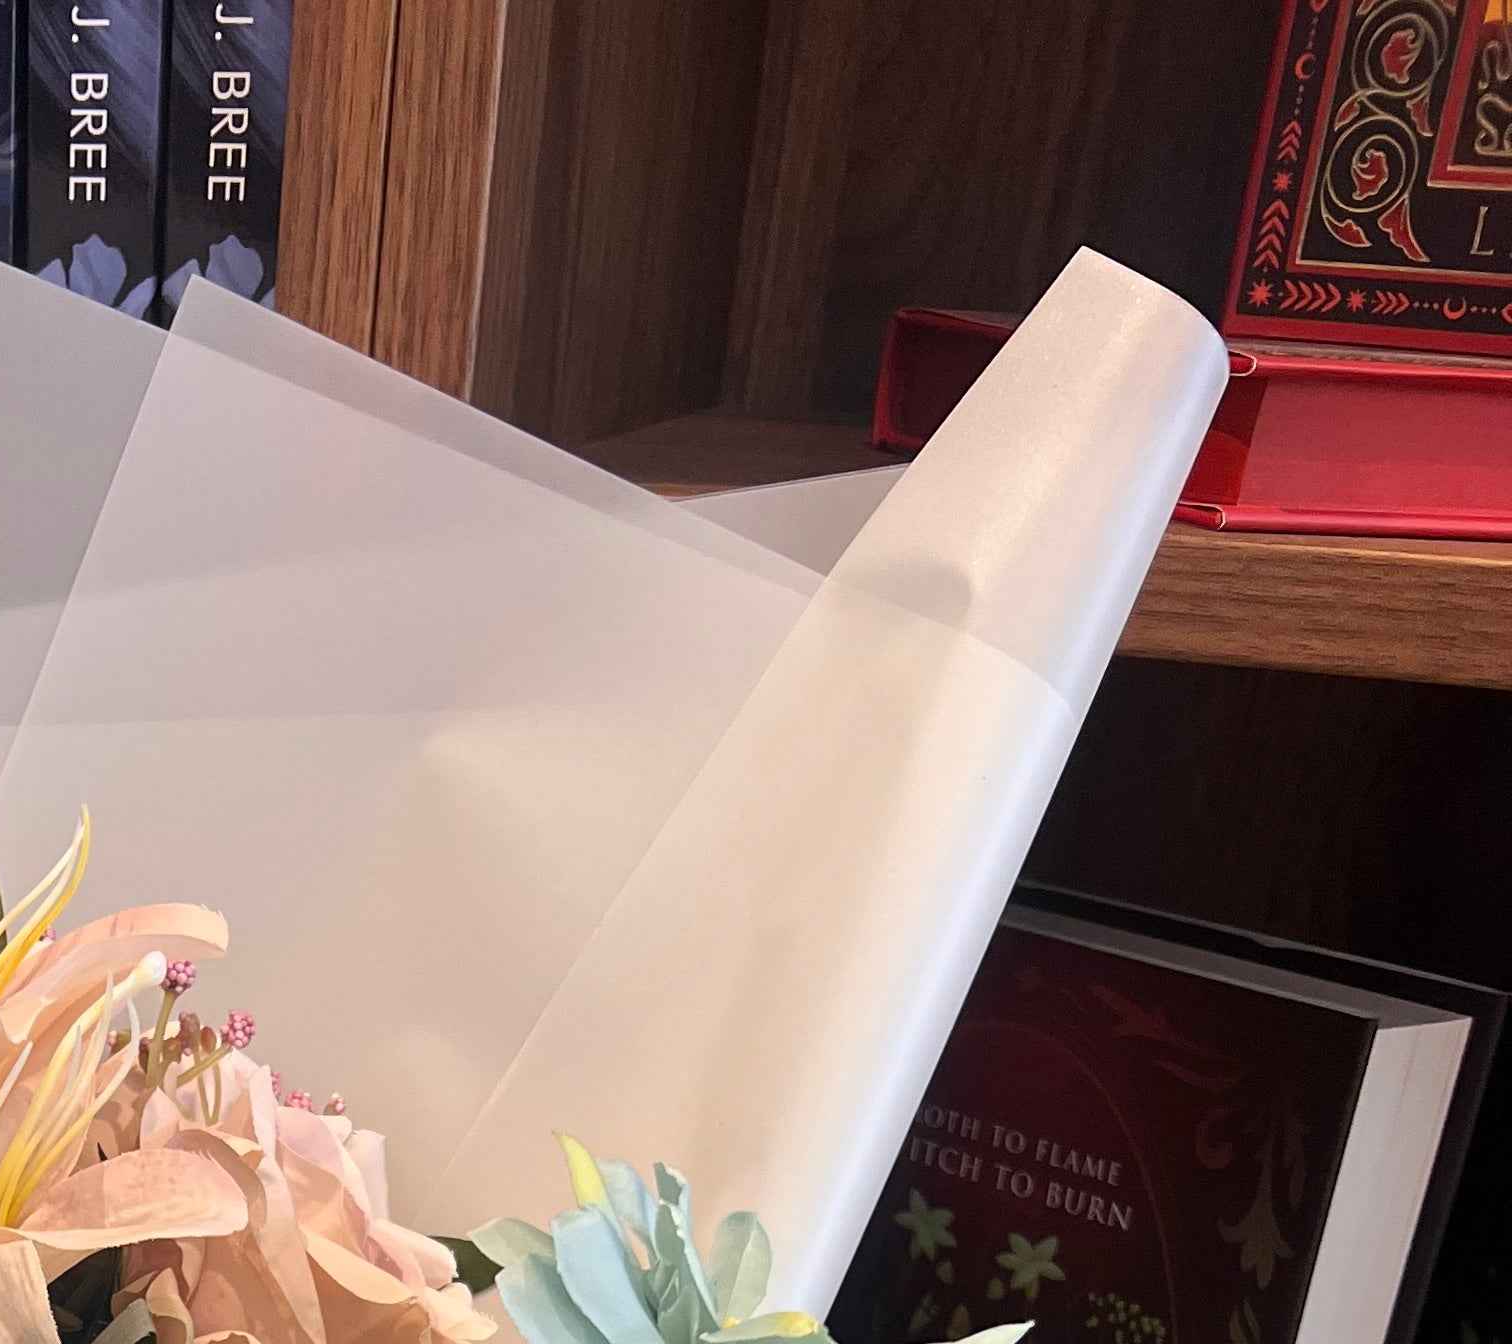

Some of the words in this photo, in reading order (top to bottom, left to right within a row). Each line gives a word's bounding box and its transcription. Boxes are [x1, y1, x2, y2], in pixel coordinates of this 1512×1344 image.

[70, 5, 109, 43] J.
[214, 5, 253, 42] J.
[68, 72, 109, 202] BREE
[207, 71, 250, 202] BREE
[909, 1135, 984, 1183] ITCH
[995, 1163, 1035, 1199] TO
[1046, 1181, 1133, 1231] BURN
[991, 1125, 1028, 1154] TO
[1034, 1139, 1122, 1187] FLAME
